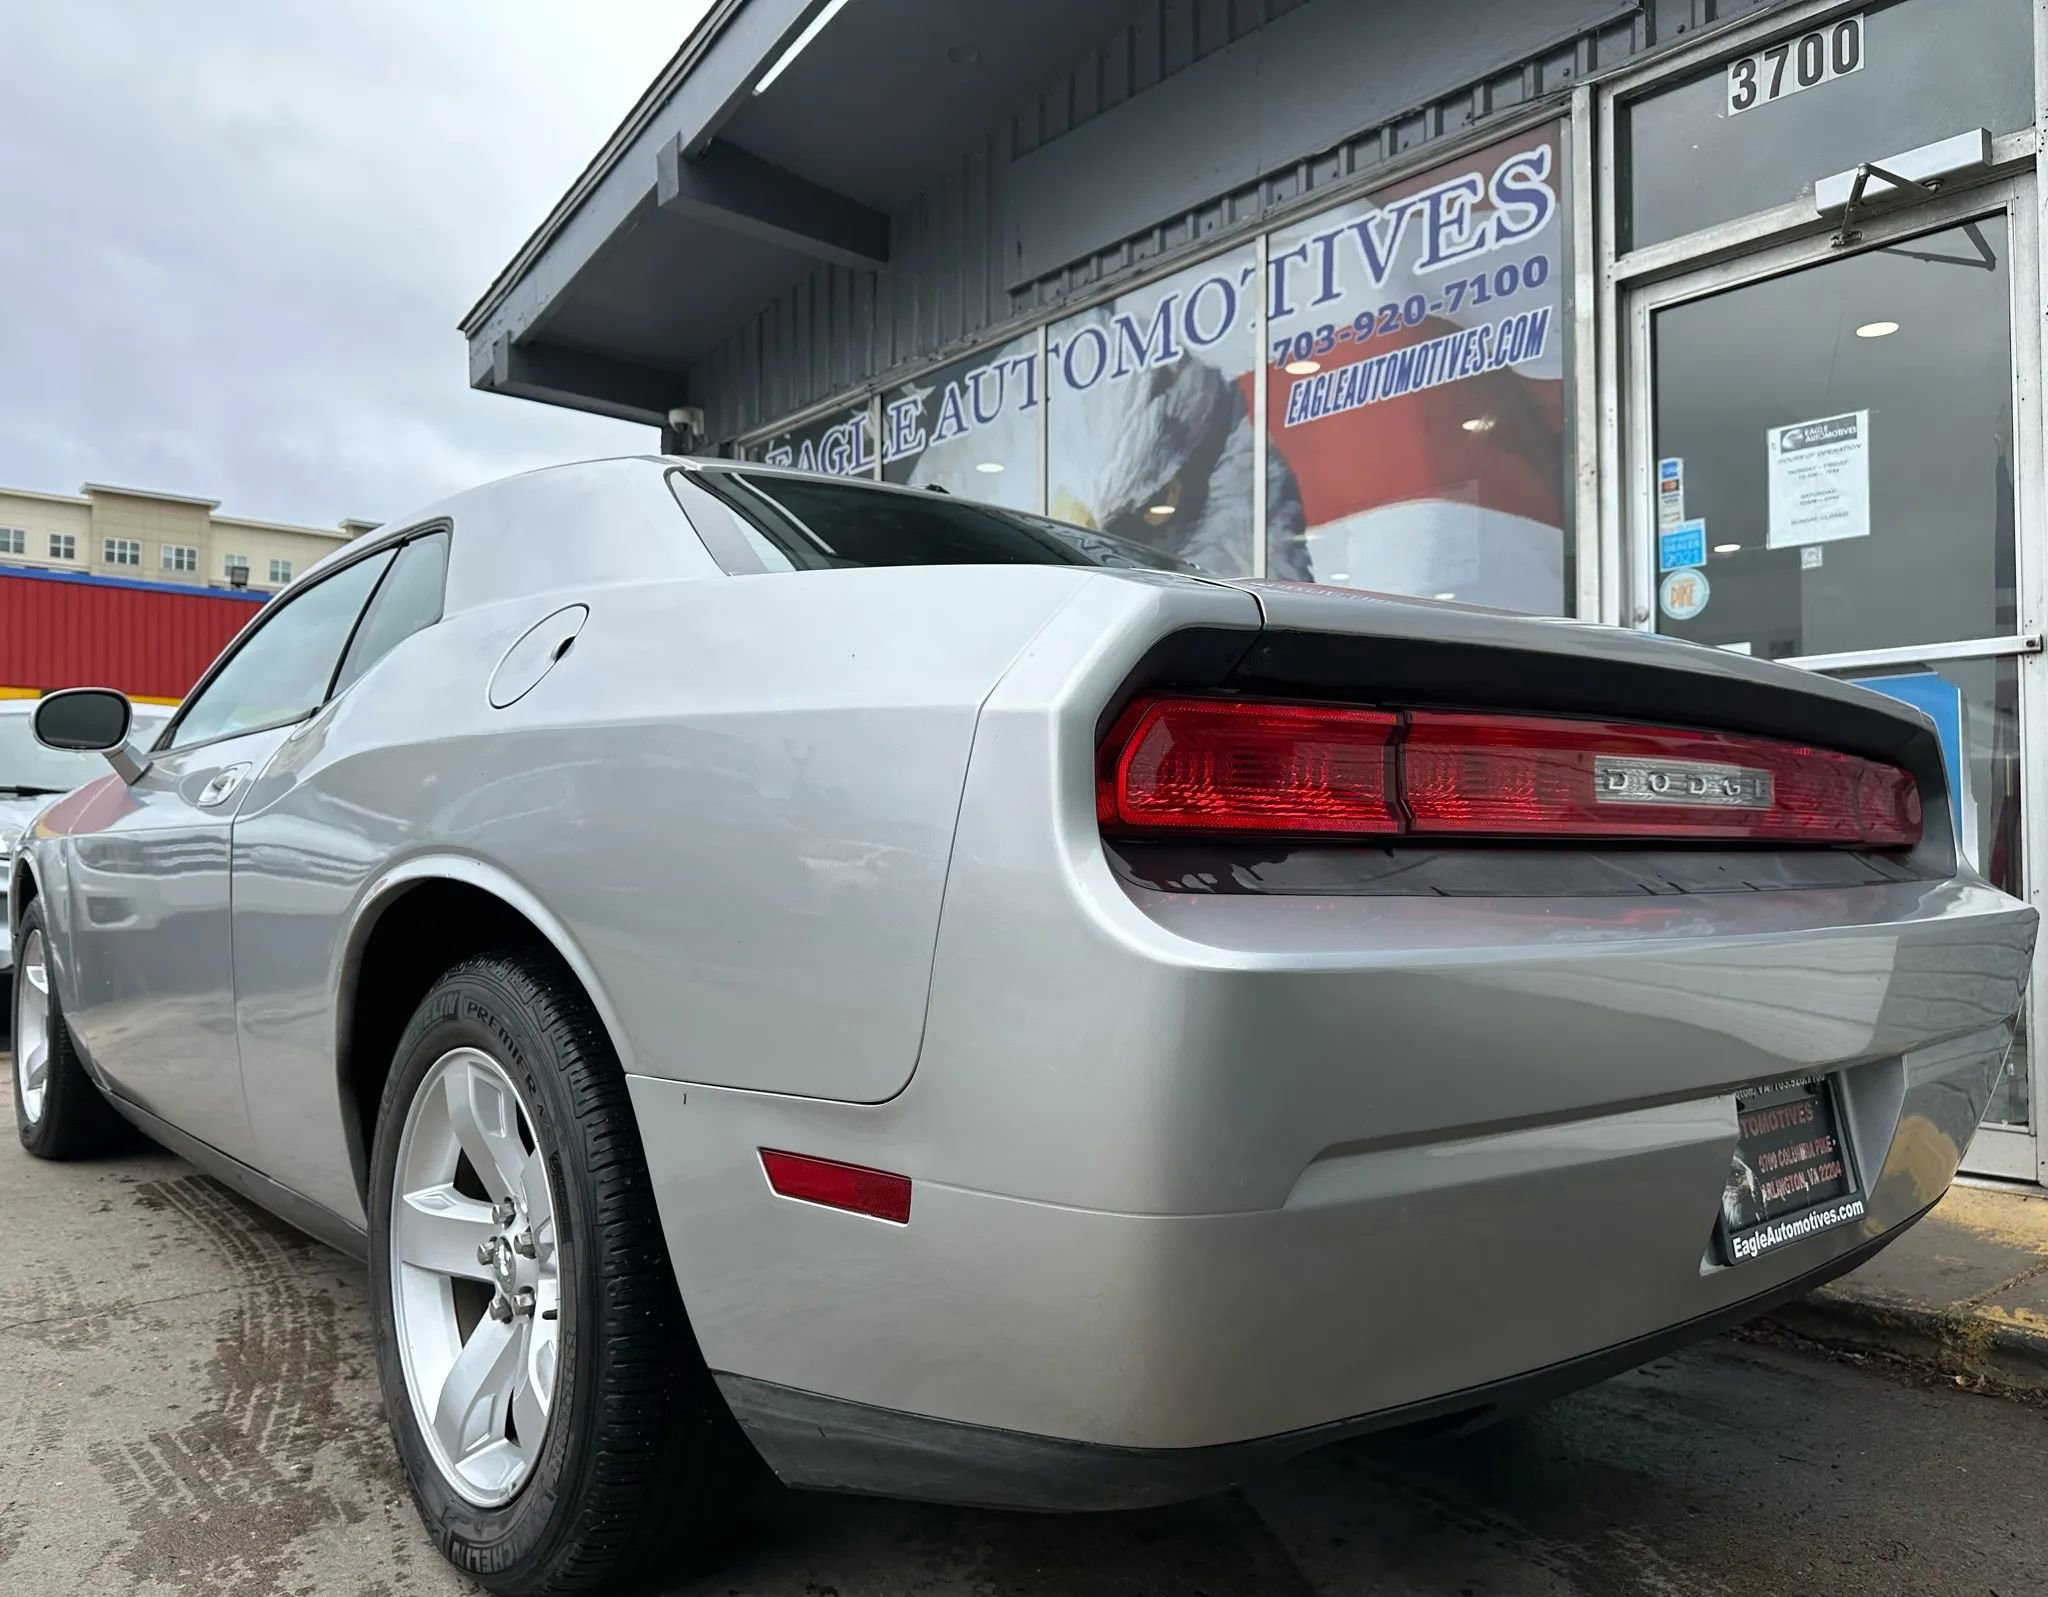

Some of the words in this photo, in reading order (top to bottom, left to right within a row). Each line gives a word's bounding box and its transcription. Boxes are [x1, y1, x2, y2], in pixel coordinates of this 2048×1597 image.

[1732, 20, 1859, 110] 3700
[929, 143, 1555, 446] AUTOMOTIVES
[1273, 255, 1549, 369] 703-920-7100
[1284, 306, 1552, 428] EAGLEAUTOMOTIVES.COM
[1804, 425, 1828, 436] EAGLE
[467, 1001, 537, 1097] PREMIER
[1733, 1199, 1864, 1258] EagleAutomotives.com
